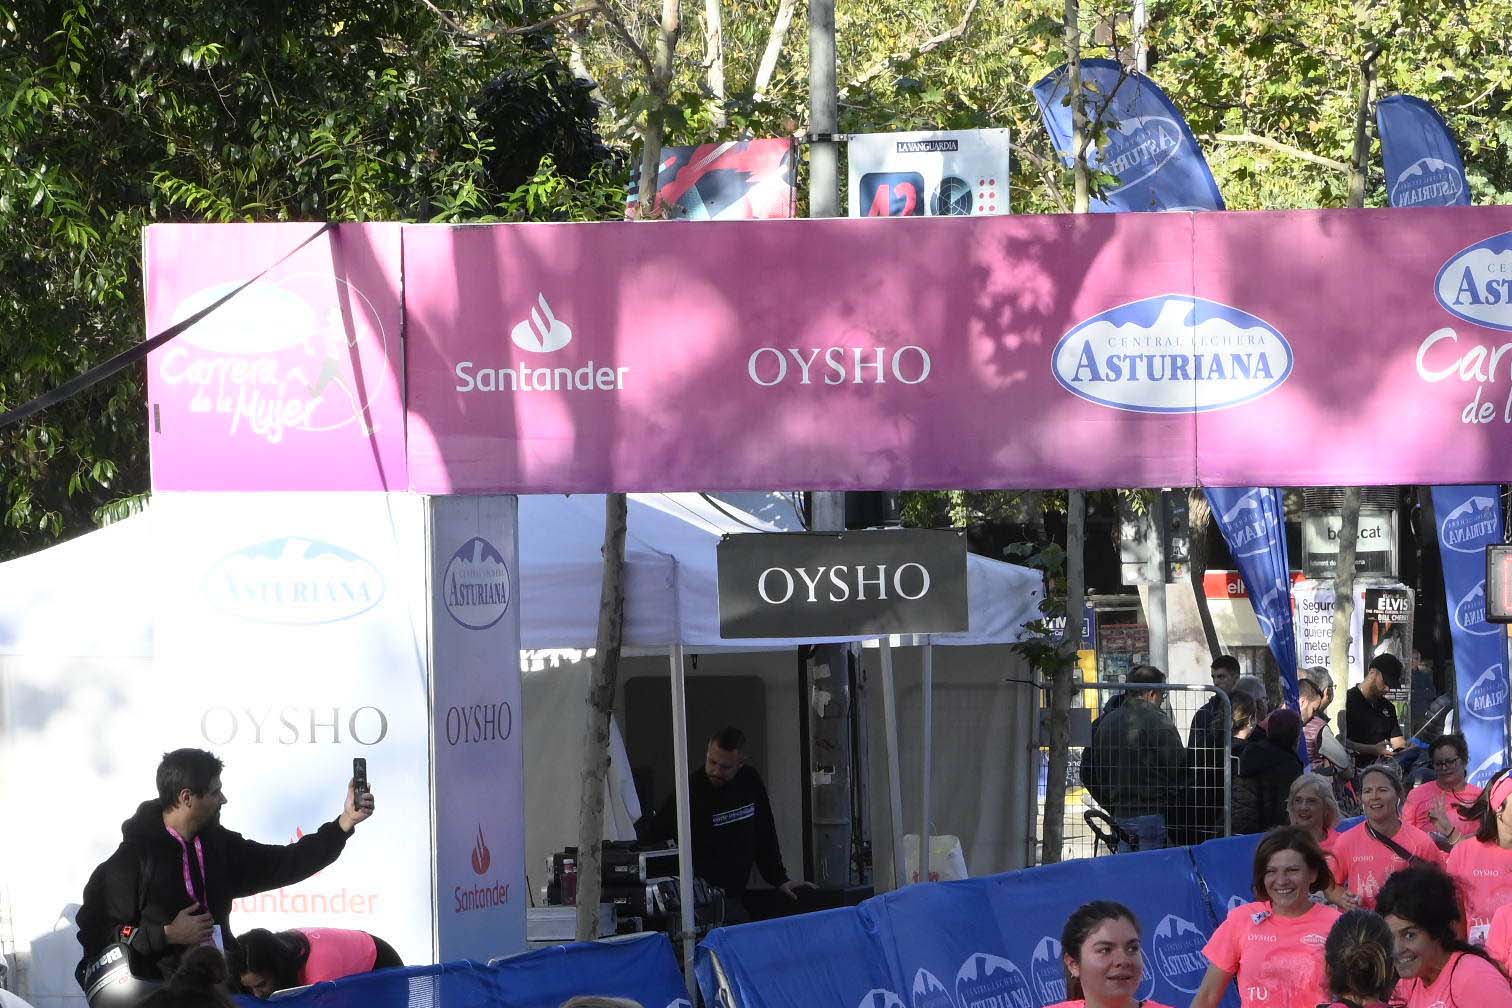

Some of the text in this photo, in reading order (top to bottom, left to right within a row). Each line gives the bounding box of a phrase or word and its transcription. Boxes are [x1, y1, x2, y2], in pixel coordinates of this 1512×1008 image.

[1107, 335, 1182, 347] CENTRAL
[455, 360, 629, 393] Santander
[747, 345, 932, 387] OYSHO
[1071, 340, 1273, 382] ASTURIANA
[1461, 386, 1496, 424] de
[448, 571, 507, 607] ASTURIANA
[757, 562, 931, 604] OYSHO
[1377, 597, 1409, 611] ELVIS
[1304, 615, 1319, 625] que
[1304, 628, 1333, 640] quiere
[1304, 654, 1324, 665] este
[200, 705, 388, 746] OYSHO
[446, 700, 512, 746] OYSHO
[232, 887, 378, 914] antander
[455, 883, 510, 913] Santander
[1247, 987, 1268, 1001] TU
